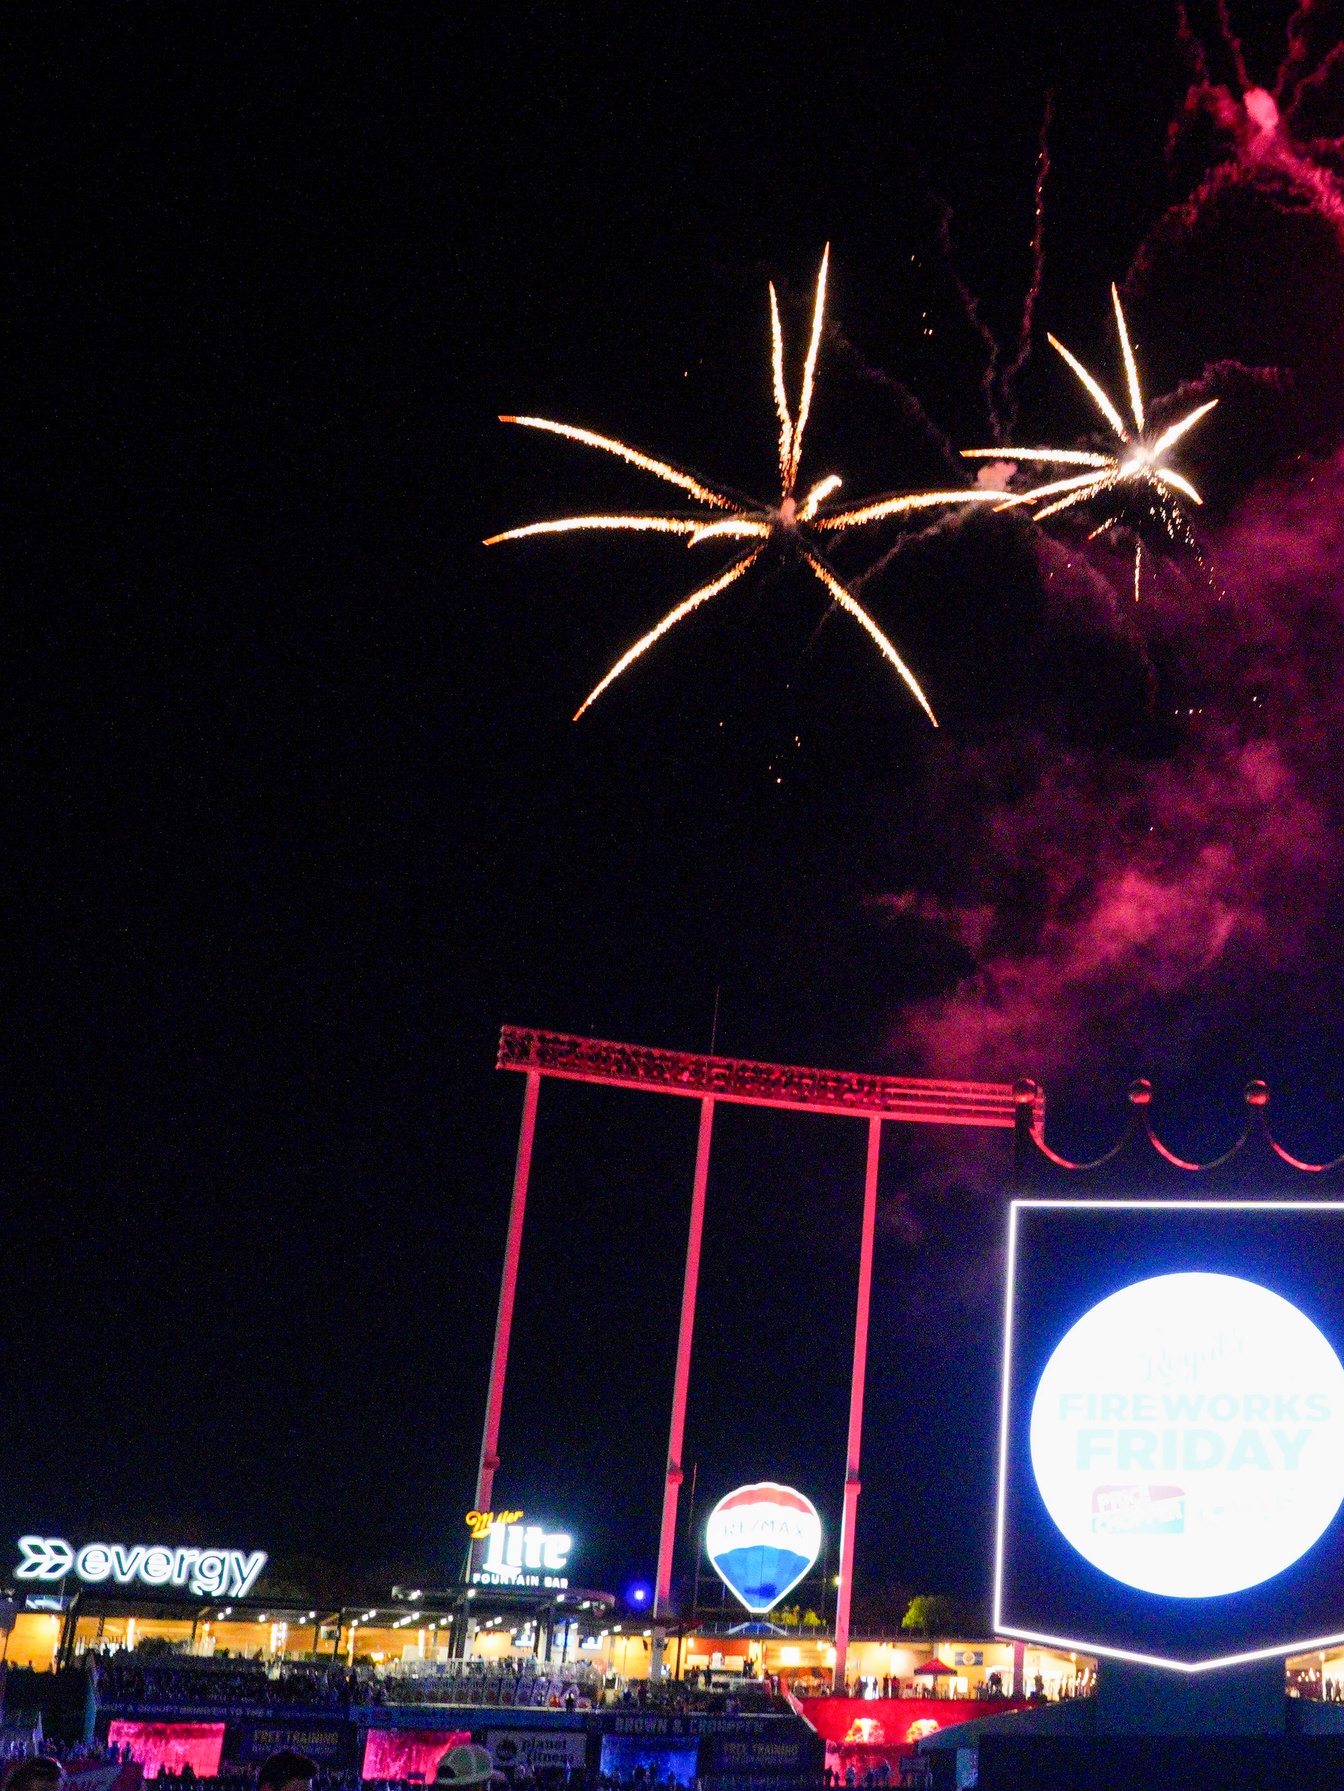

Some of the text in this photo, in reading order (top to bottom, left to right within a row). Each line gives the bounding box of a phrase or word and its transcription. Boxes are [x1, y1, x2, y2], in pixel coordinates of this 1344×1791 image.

[1058, 1393, 1333, 1422] FIREWORKS
[1076, 1428, 1314, 1471] FRIDAY
[482, 1522, 571, 1574] Lite
[79, 1544, 266, 1598] evergy
[473, 1573, 569, 1589] FOUNTAIN BAR
